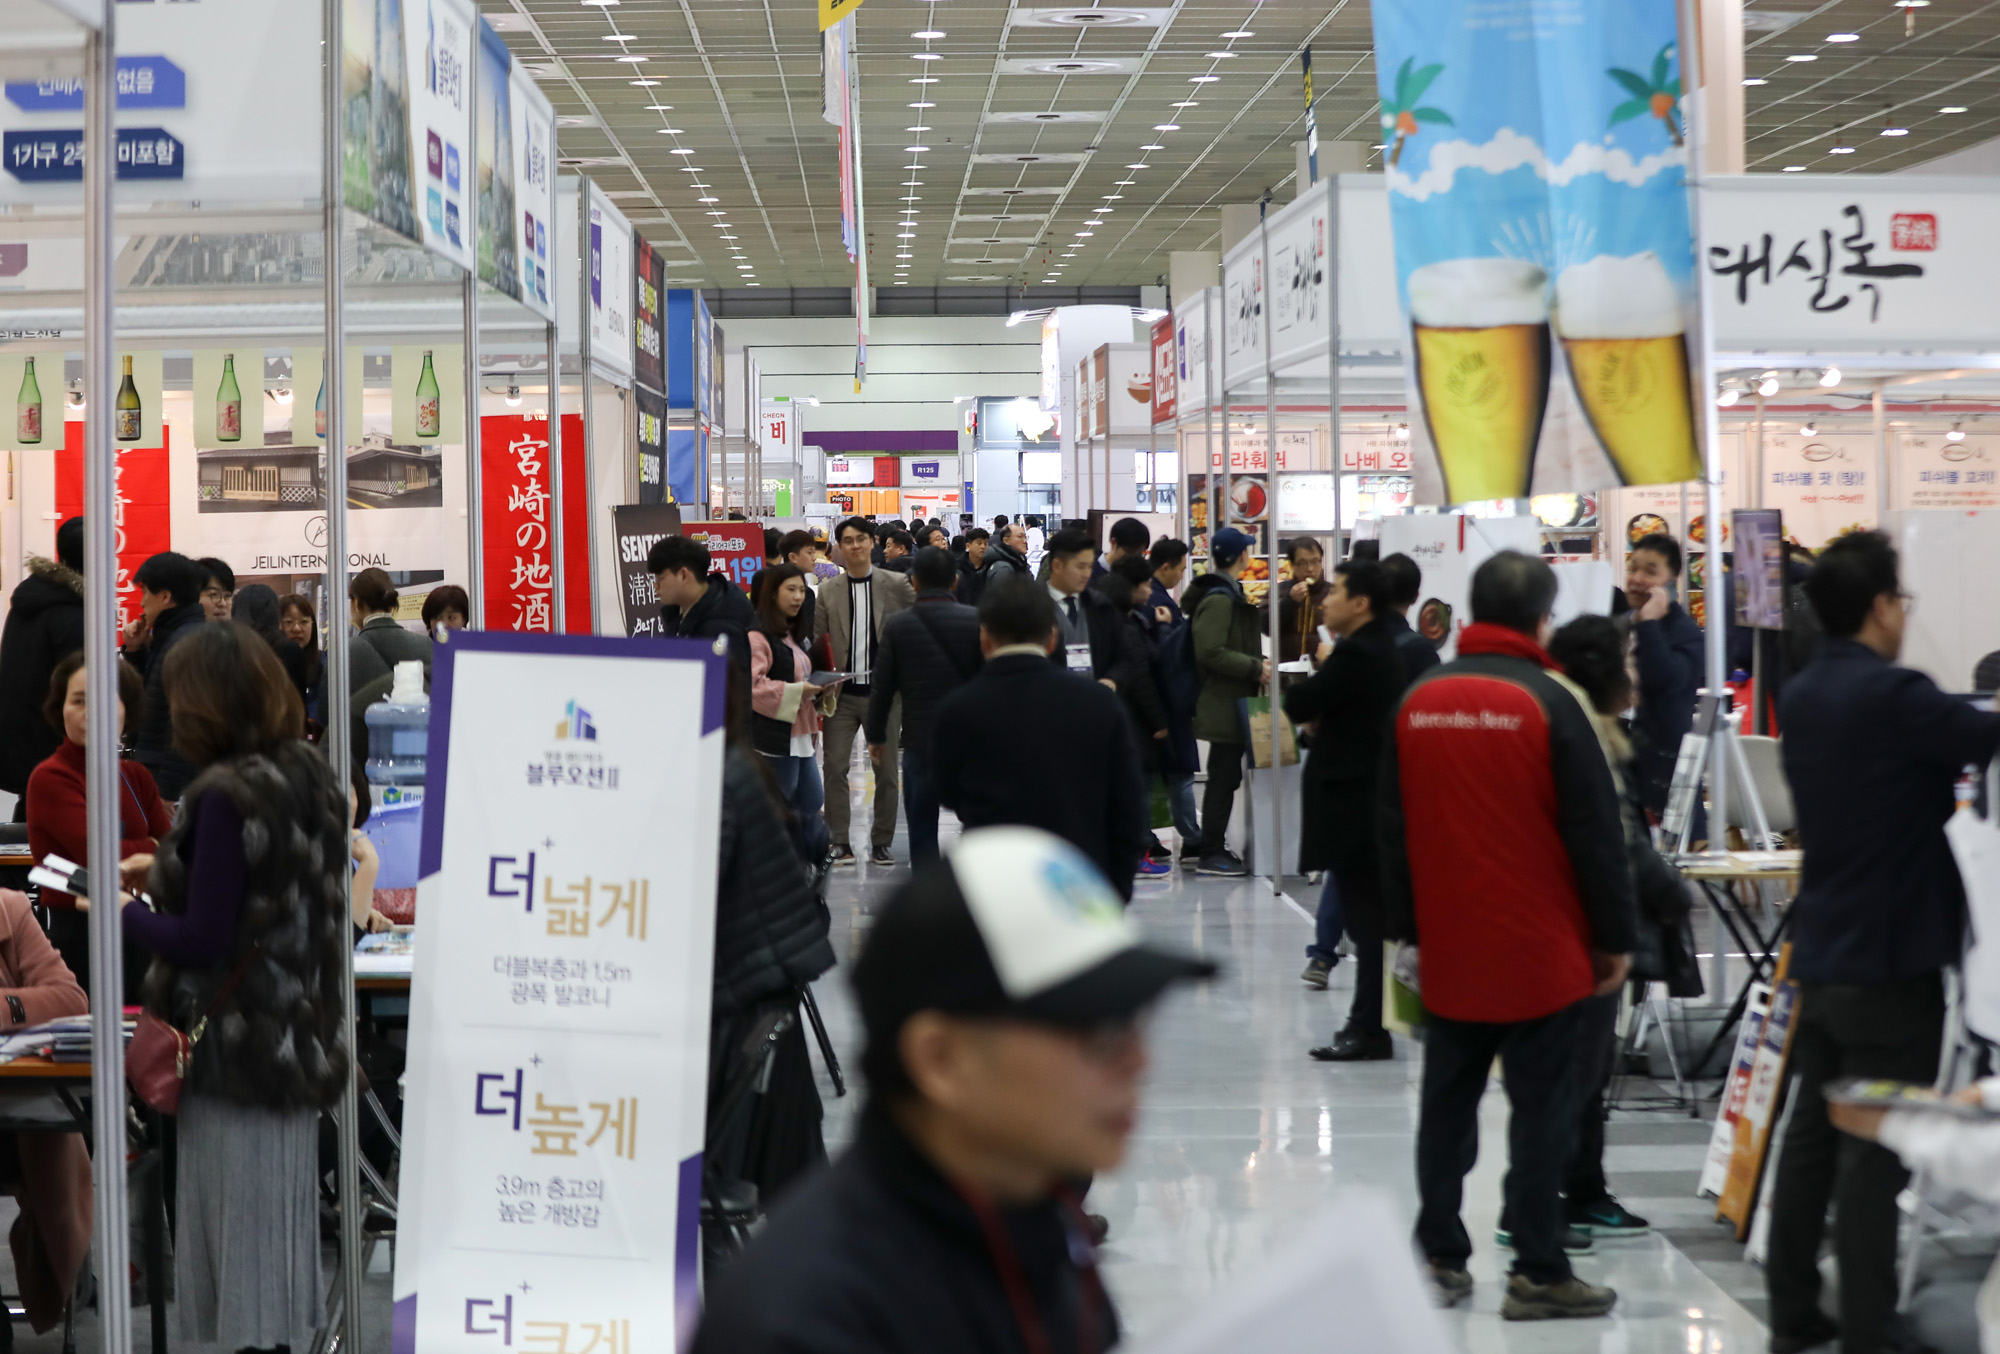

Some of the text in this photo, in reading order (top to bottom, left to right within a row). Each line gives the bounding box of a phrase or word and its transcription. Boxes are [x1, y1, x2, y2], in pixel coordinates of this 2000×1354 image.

[12, 142, 58, 168] 1가구
[118, 138, 175, 167] 미포함
[761, 421, 785, 444] 비
[1344, 452, 1381, 470] 나베
[508, 433, 552, 632] 宮崎の地酒
[251, 553, 391, 570] JEILINTERNIONAL
[730, 556, 762, 585] 1위
[488, 851, 650, 942] 더 넓게
[554, 985, 611, 1009] 발코니
[475, 1068, 638, 1161] 더 높게
[546, 1176, 605, 1202] 층고의
[498, 1199, 600, 1229] 높은 개방감
[465, 1294, 512, 1346] 더
